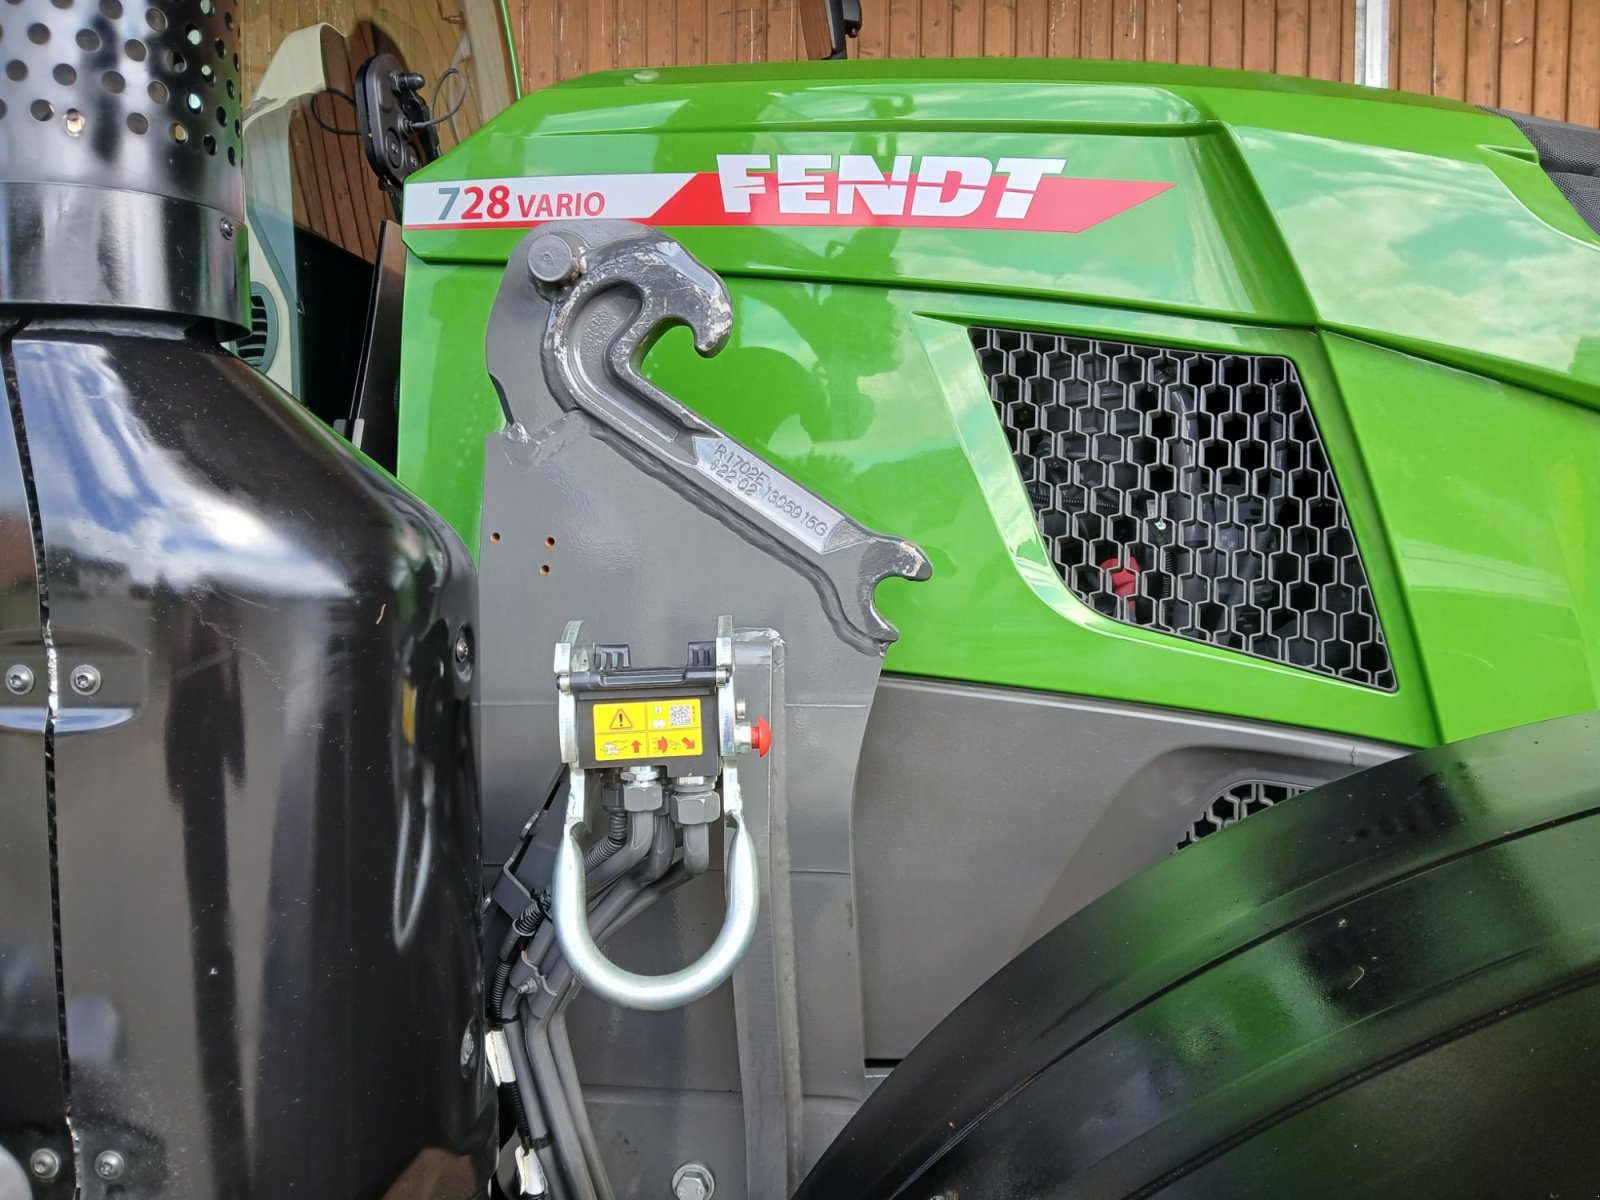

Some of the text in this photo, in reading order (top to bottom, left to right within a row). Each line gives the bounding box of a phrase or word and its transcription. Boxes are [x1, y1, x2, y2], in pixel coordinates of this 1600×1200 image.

[438, 185, 606, 220] 728 VARIO
[716, 154, 1067, 219] FENDT
